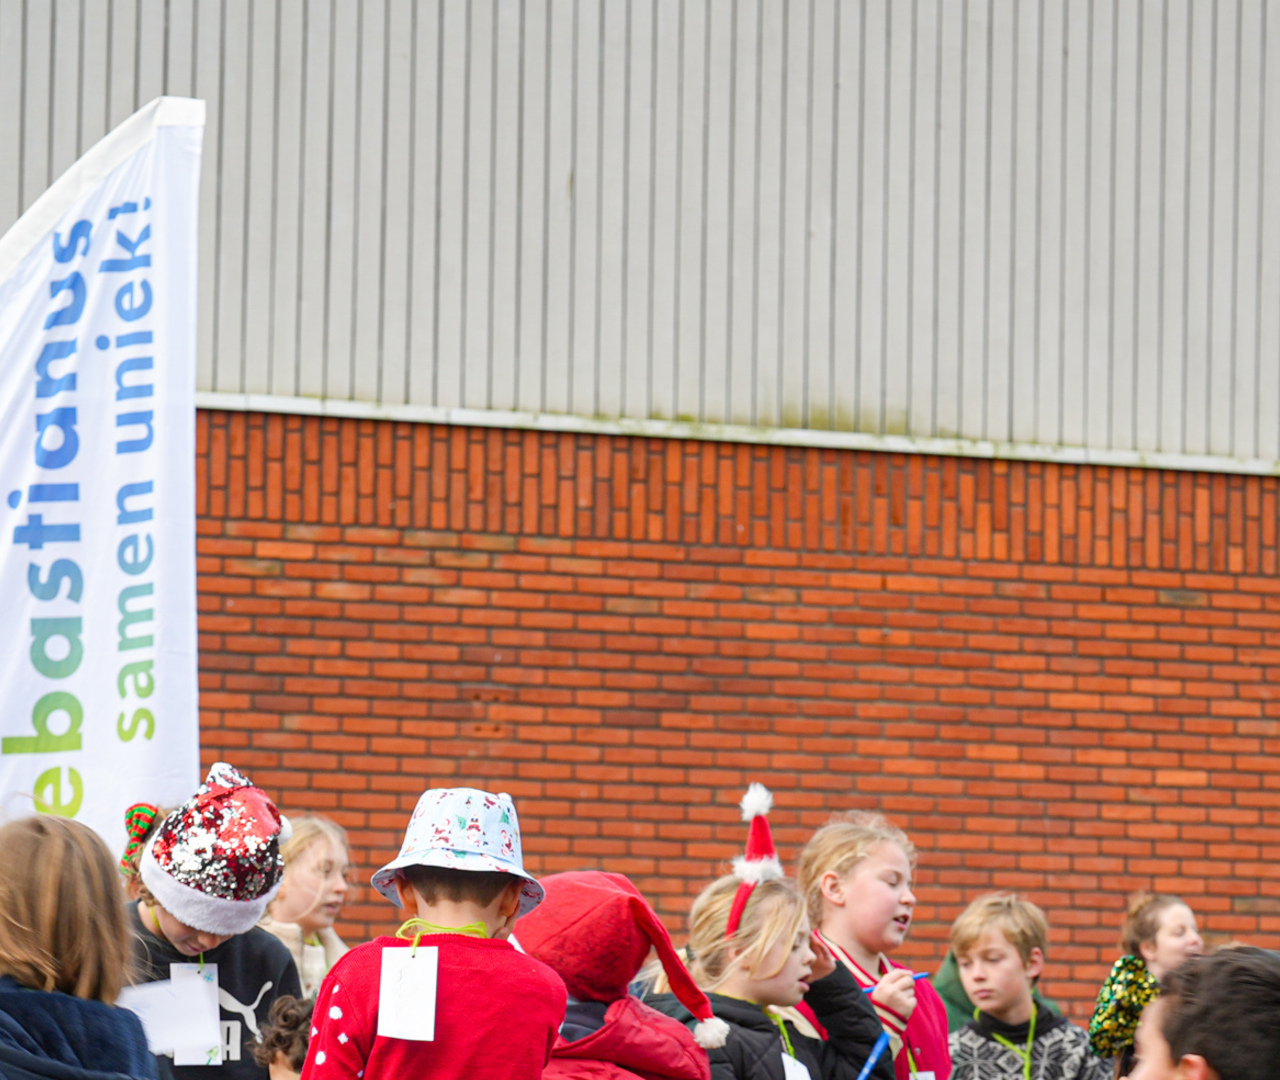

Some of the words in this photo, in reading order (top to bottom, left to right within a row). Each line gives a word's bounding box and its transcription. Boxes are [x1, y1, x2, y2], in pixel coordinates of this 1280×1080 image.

[96, 196, 154, 455] uniek!
[1, 217, 94, 819] ebastianus
[116, 479, 155, 741] samen
